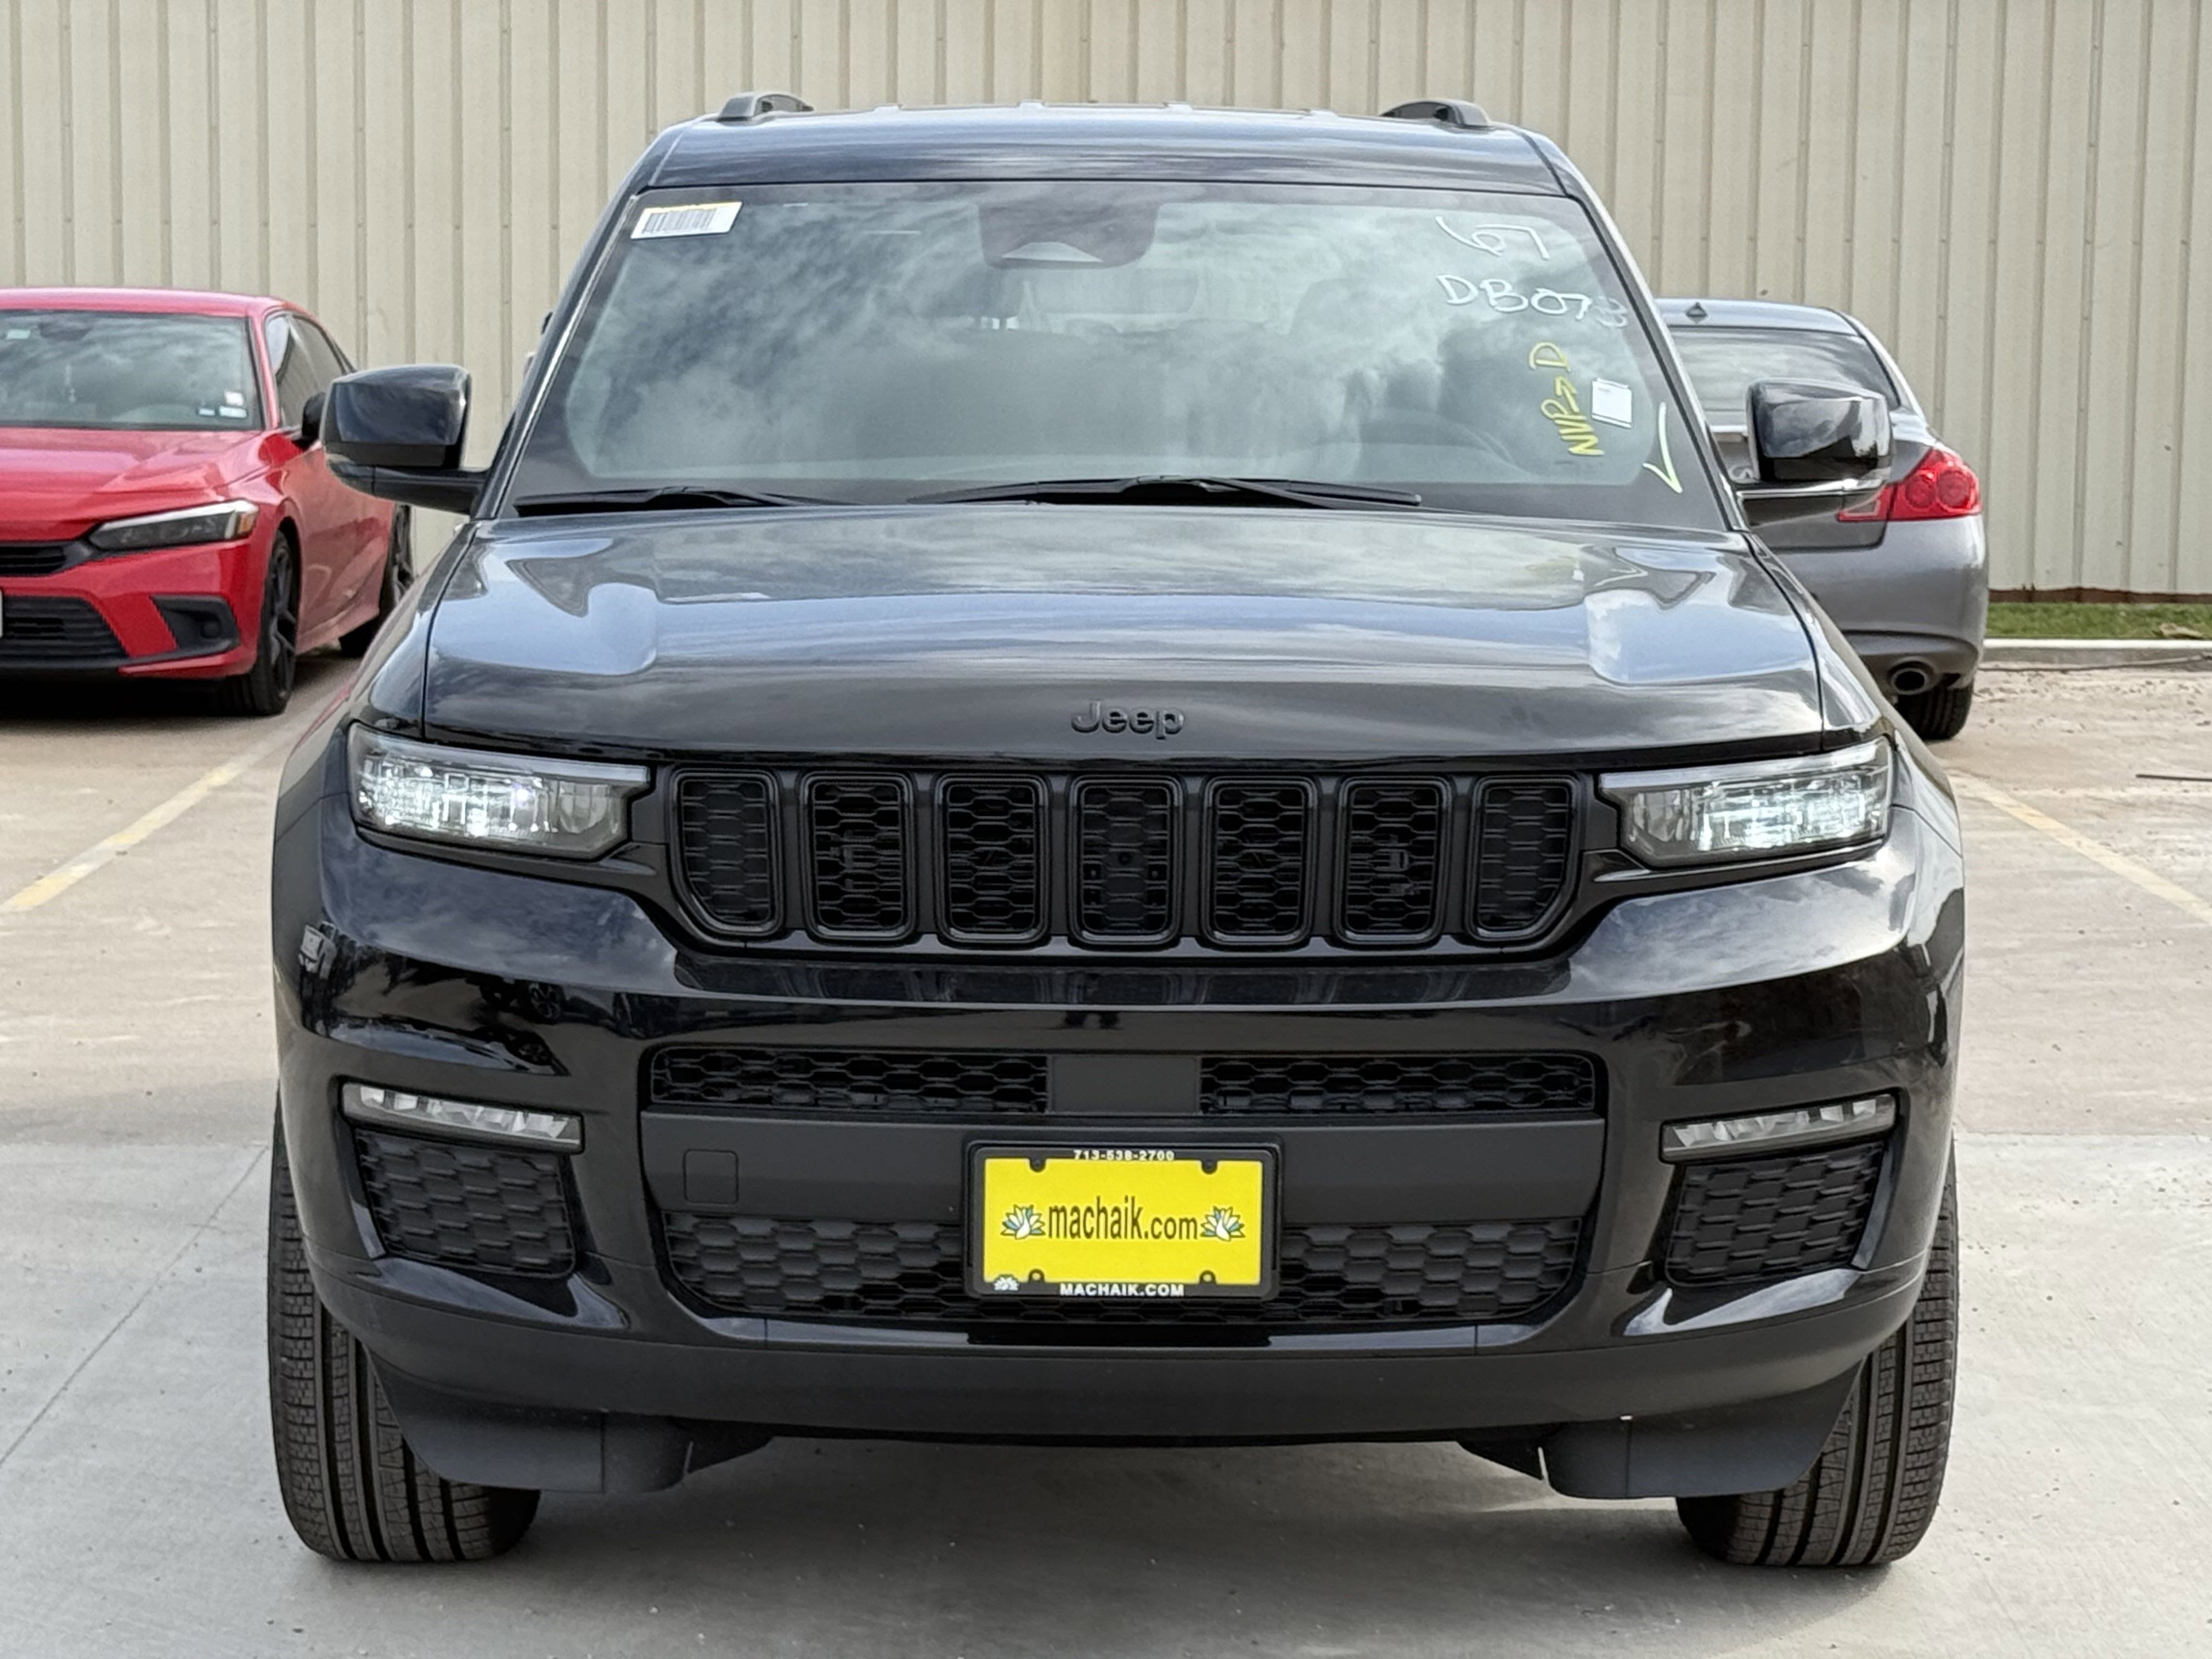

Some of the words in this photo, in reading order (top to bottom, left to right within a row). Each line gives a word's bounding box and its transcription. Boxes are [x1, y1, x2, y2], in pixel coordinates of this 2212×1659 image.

[1435, 216, 1550, 260] 67
[1071, 701, 1184, 740] Jeep
[1048, 1195, 1198, 1240] machaik.com
[1059, 1283, 1184, 1297] MACHAIK.COM
